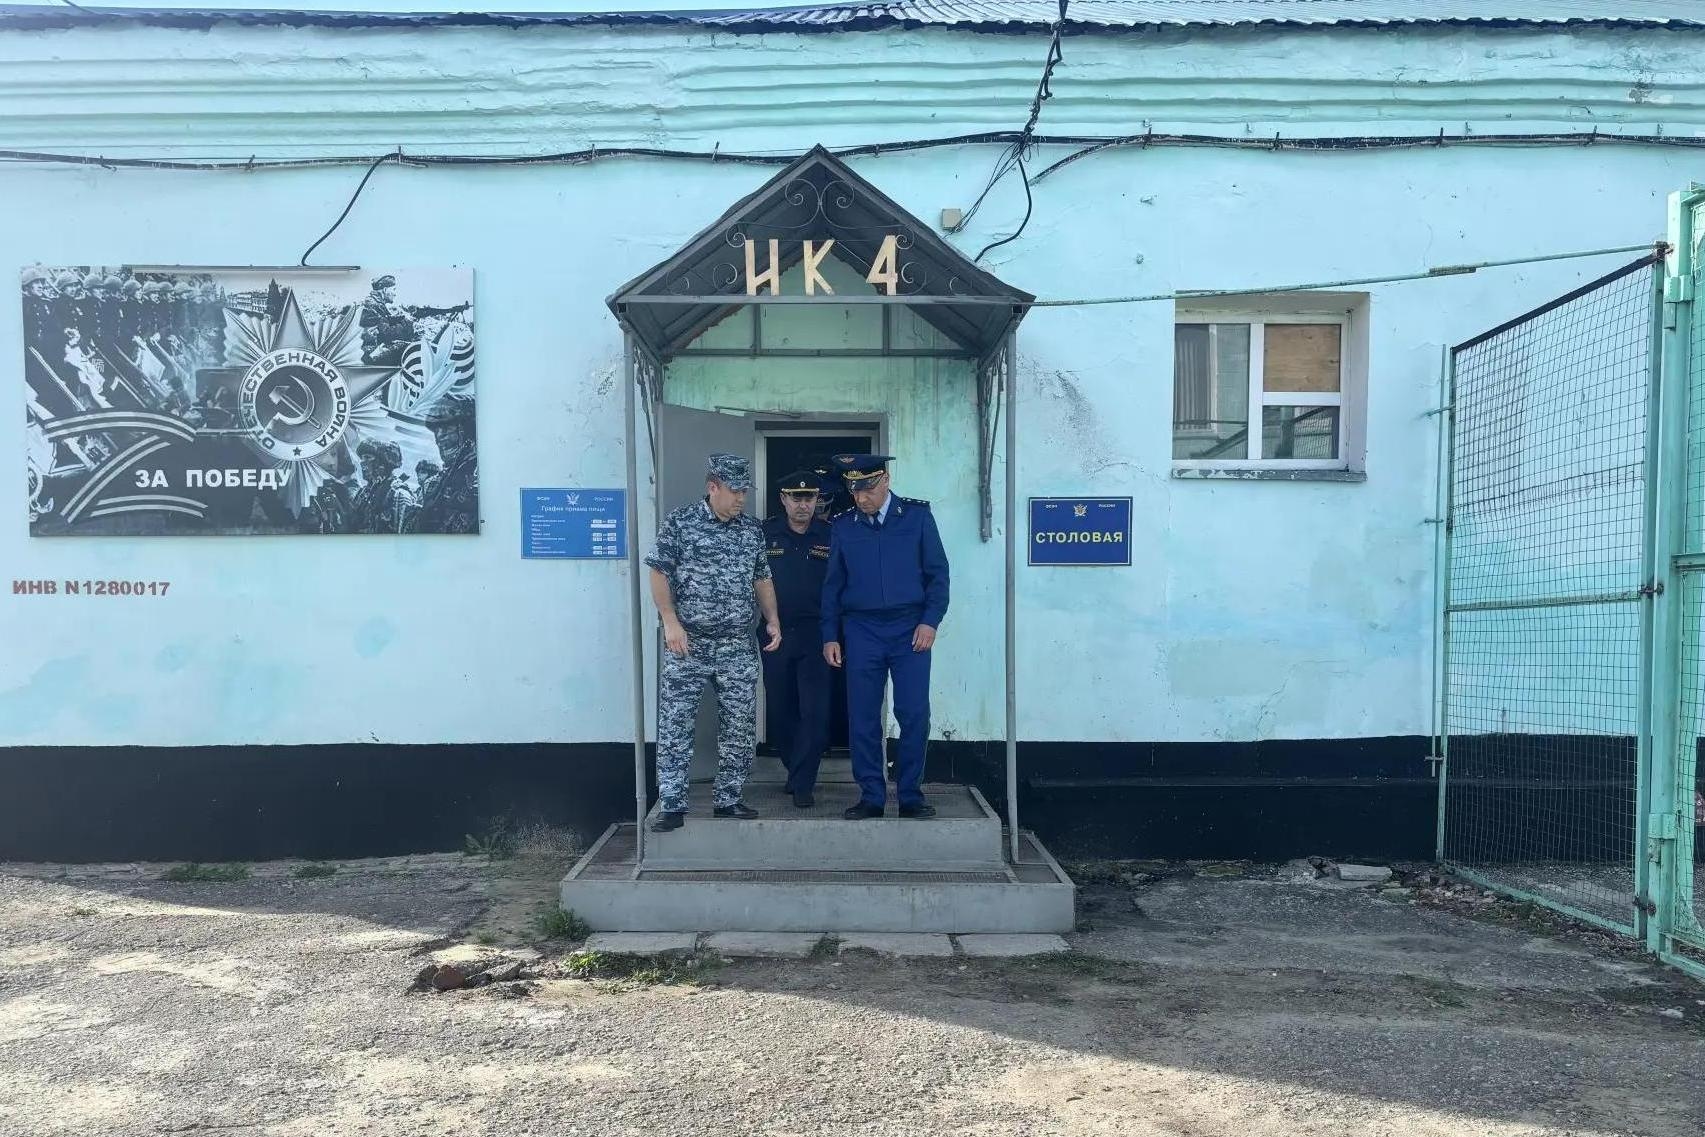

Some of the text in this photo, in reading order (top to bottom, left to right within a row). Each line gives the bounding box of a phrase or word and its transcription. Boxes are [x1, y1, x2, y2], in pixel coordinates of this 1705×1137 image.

[865, 235, 898, 296] 4
[242, 352, 339, 450] ОТЕЧЕСТВЕННАЯ
[135, 468, 292, 490] ЗА ПОБЕДУ
[1036, 532, 1122, 543] СТОЛОВАЯ
[12, 580, 58, 595] ИНВ
